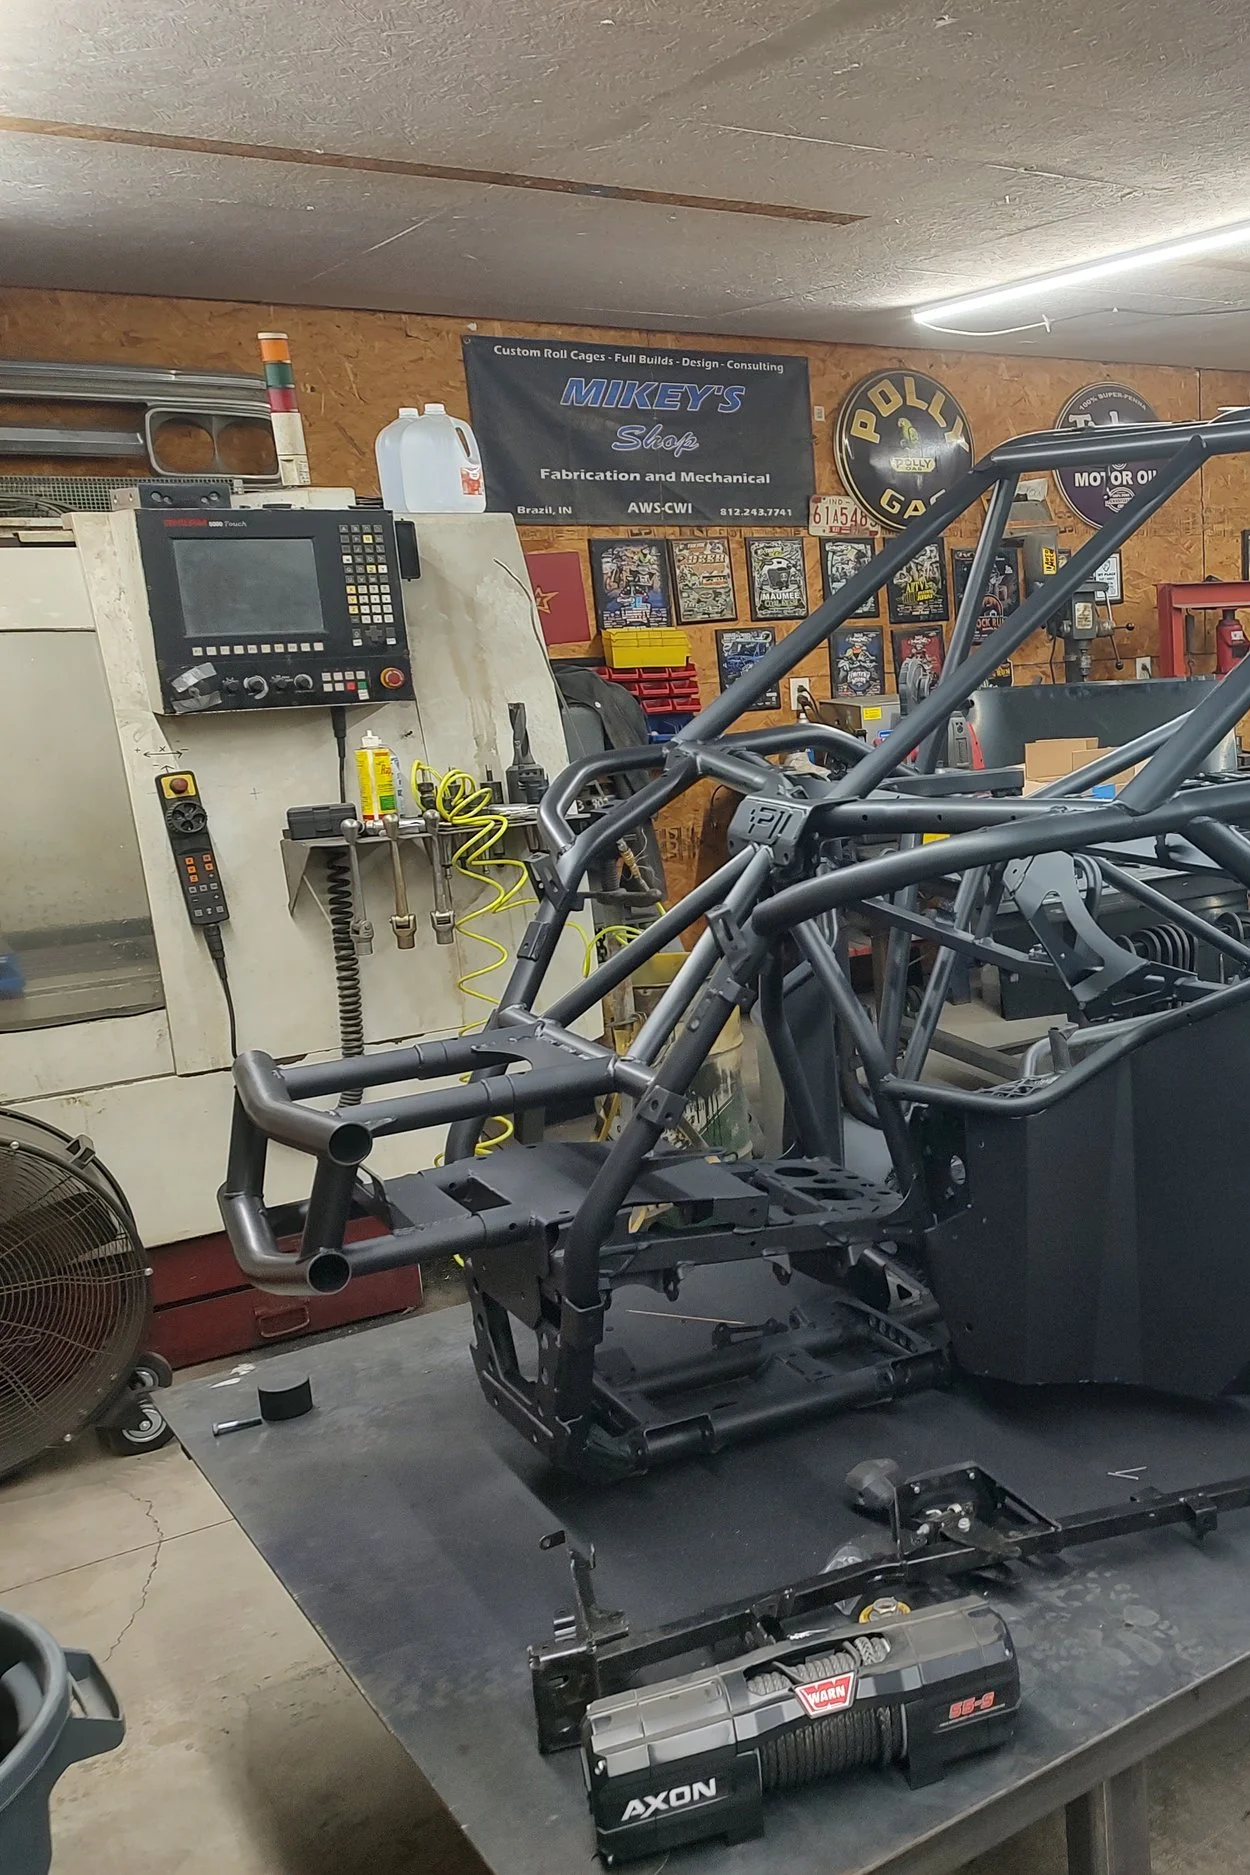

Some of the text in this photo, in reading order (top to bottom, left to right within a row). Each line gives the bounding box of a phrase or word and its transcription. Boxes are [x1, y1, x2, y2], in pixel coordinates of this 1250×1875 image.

[494, 345, 541, 358] Custom
[544, 348, 567, 359] Roll
[570, 350, 606, 363] Cages
[614, 353, 636, 364] Full
[639, 354, 674, 366] Builds
[682, 358, 719, 370] Design
[726, 360, 784, 374] Consulting
[560, 377, 745, 414] MIKEY'S
[850, 376, 970, 453] POLLY
[612, 424, 699, 458] Shop
[895, 458, 932, 469] POLLY
[540, 468, 770, 484] Fabrication and Mechanical
[1137, 470, 1157, 485] OI
[516, 505, 572, 518] Brazil, IN
[627, 502, 692, 515] AWS-CWI
[720, 507, 792, 516] 812.243.7741
[879, 488, 946, 519] GA
[224, 520, 247, 528] Touch
[762, 592, 800, 600] MAUMEE
[806, 1684, 845, 1705] WARN
[620, 1777, 718, 1822] AXON
